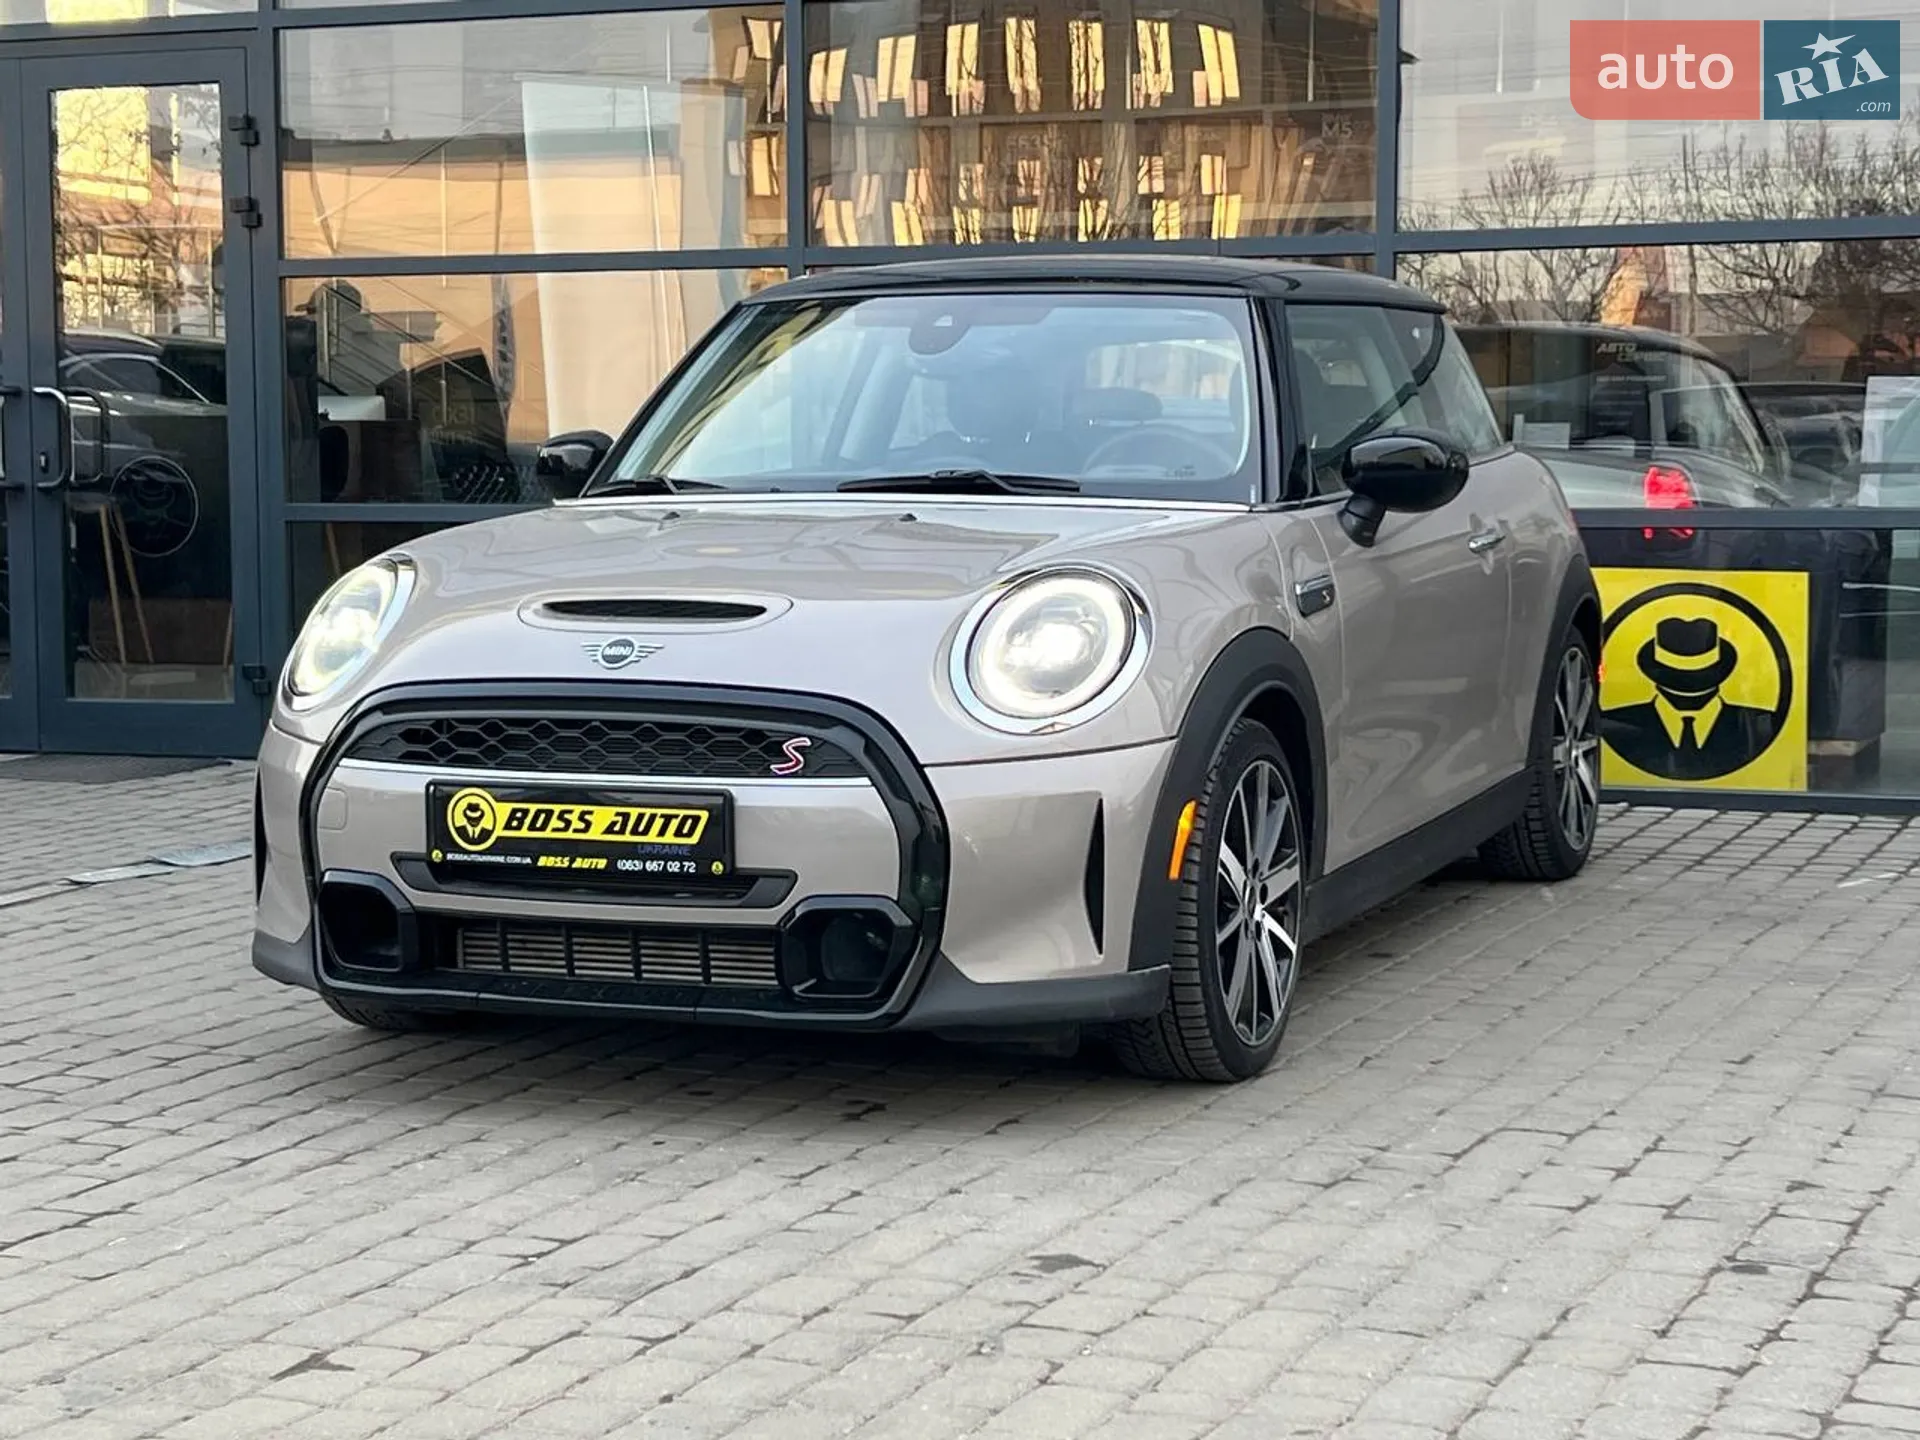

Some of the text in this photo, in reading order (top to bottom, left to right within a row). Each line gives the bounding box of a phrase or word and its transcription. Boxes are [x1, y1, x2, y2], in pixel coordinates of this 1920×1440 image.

[603, 645, 633, 656] MINI
[770, 737, 812, 775] S
[502, 807, 702, 838] BOSS AUTO
[637, 844, 692, 856] UKRAINE
[537, 855, 608, 870] BOSS AUTO
[616, 859, 697, 873] (063) 667 02 72
